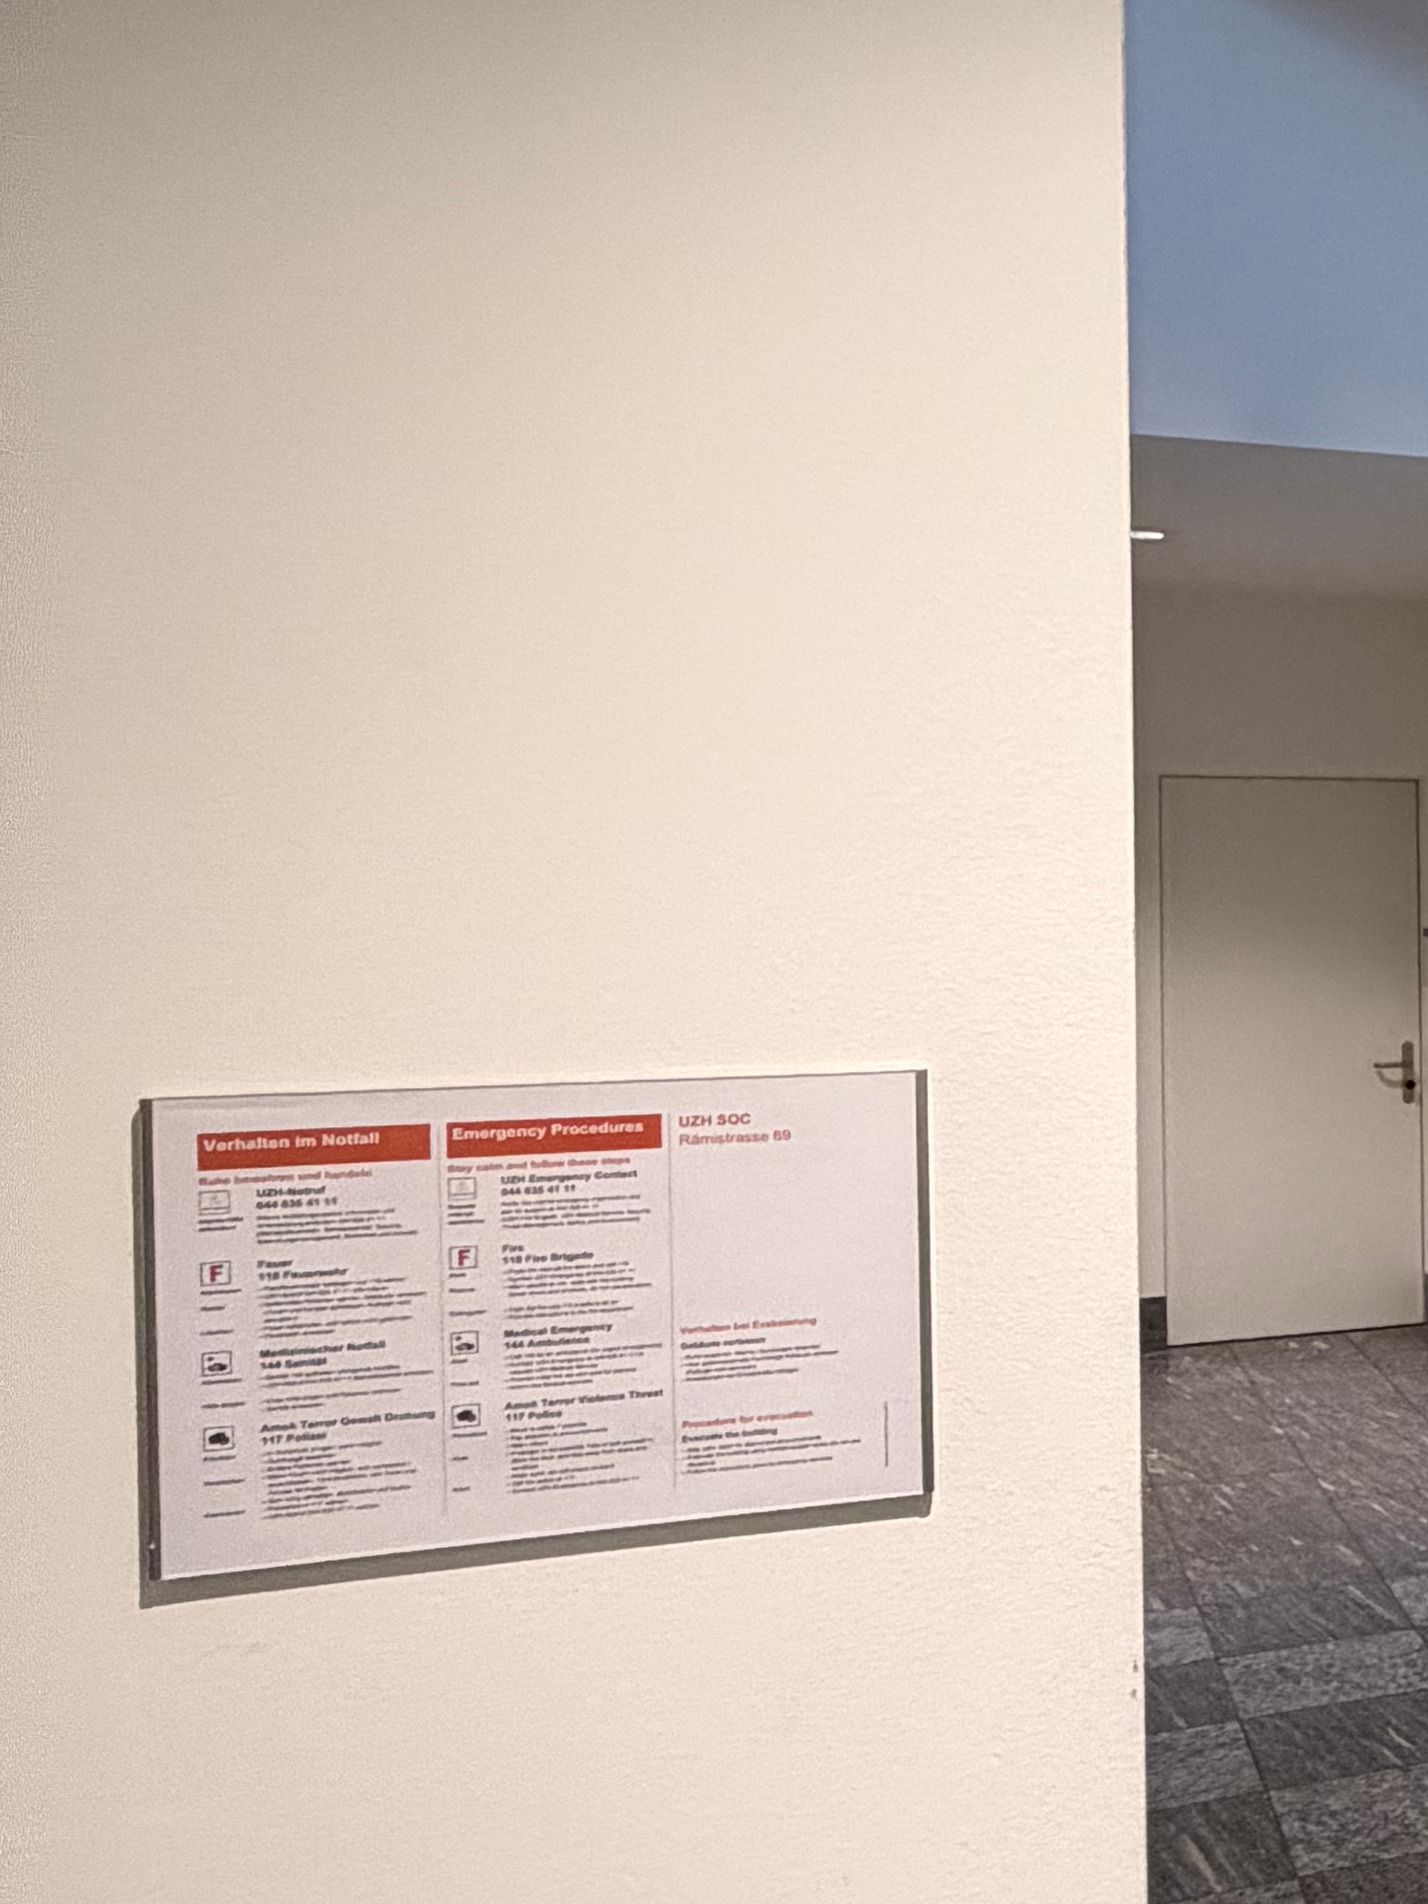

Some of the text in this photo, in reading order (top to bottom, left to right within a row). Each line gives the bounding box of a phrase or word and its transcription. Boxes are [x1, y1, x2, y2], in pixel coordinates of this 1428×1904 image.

[679, 1113, 751, 1127] UZH SOC
[452, 1121, 644, 1140] Emergency Procedures
[773, 1130, 791, 1141] 69
[203, 1133, 379, 1152] Verhalten im Notfall
